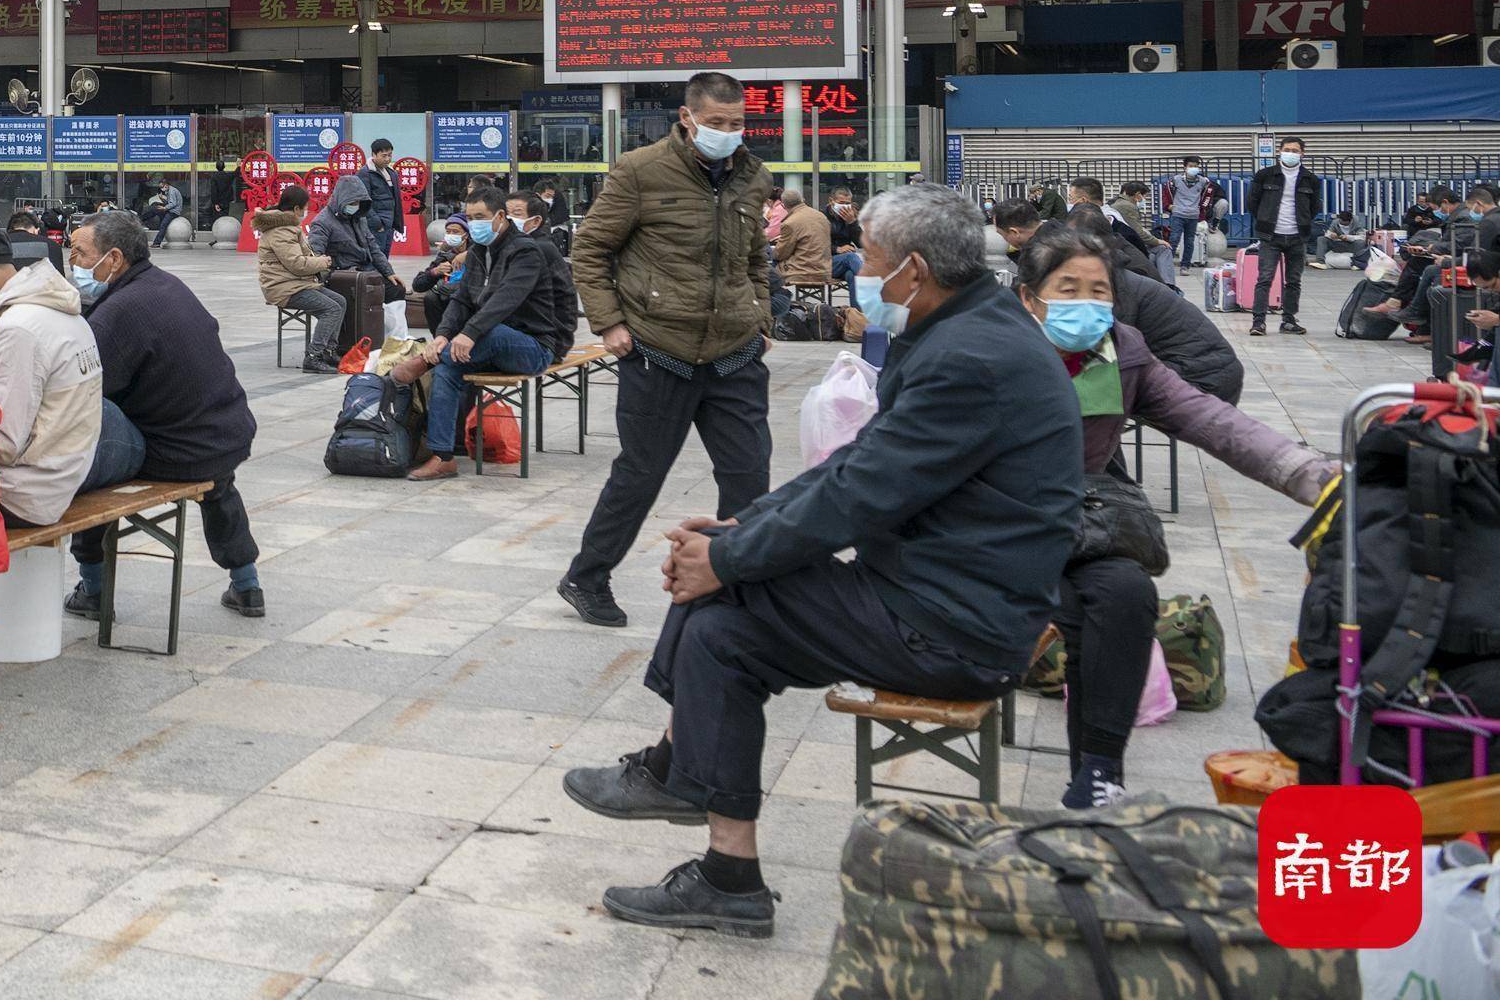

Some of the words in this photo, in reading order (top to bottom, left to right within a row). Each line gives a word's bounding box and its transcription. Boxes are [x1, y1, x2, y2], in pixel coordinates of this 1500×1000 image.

[1246, 0, 1369, 35] KFC
[129, 120, 186, 129] 进站请亮粤康码
[278, 118, 340, 128] 进站请亮粤康码
[437, 116, 503, 127] 进站请亮粤康码
[340, 153, 355, 161] 公正
[252, 170, 267, 178] 民主
[401, 168, 417, 176] 诚信
[314, 177, 329, 185] 自由
[401, 176, 418, 185] 友善
[313, 186, 329, 194] 平等
